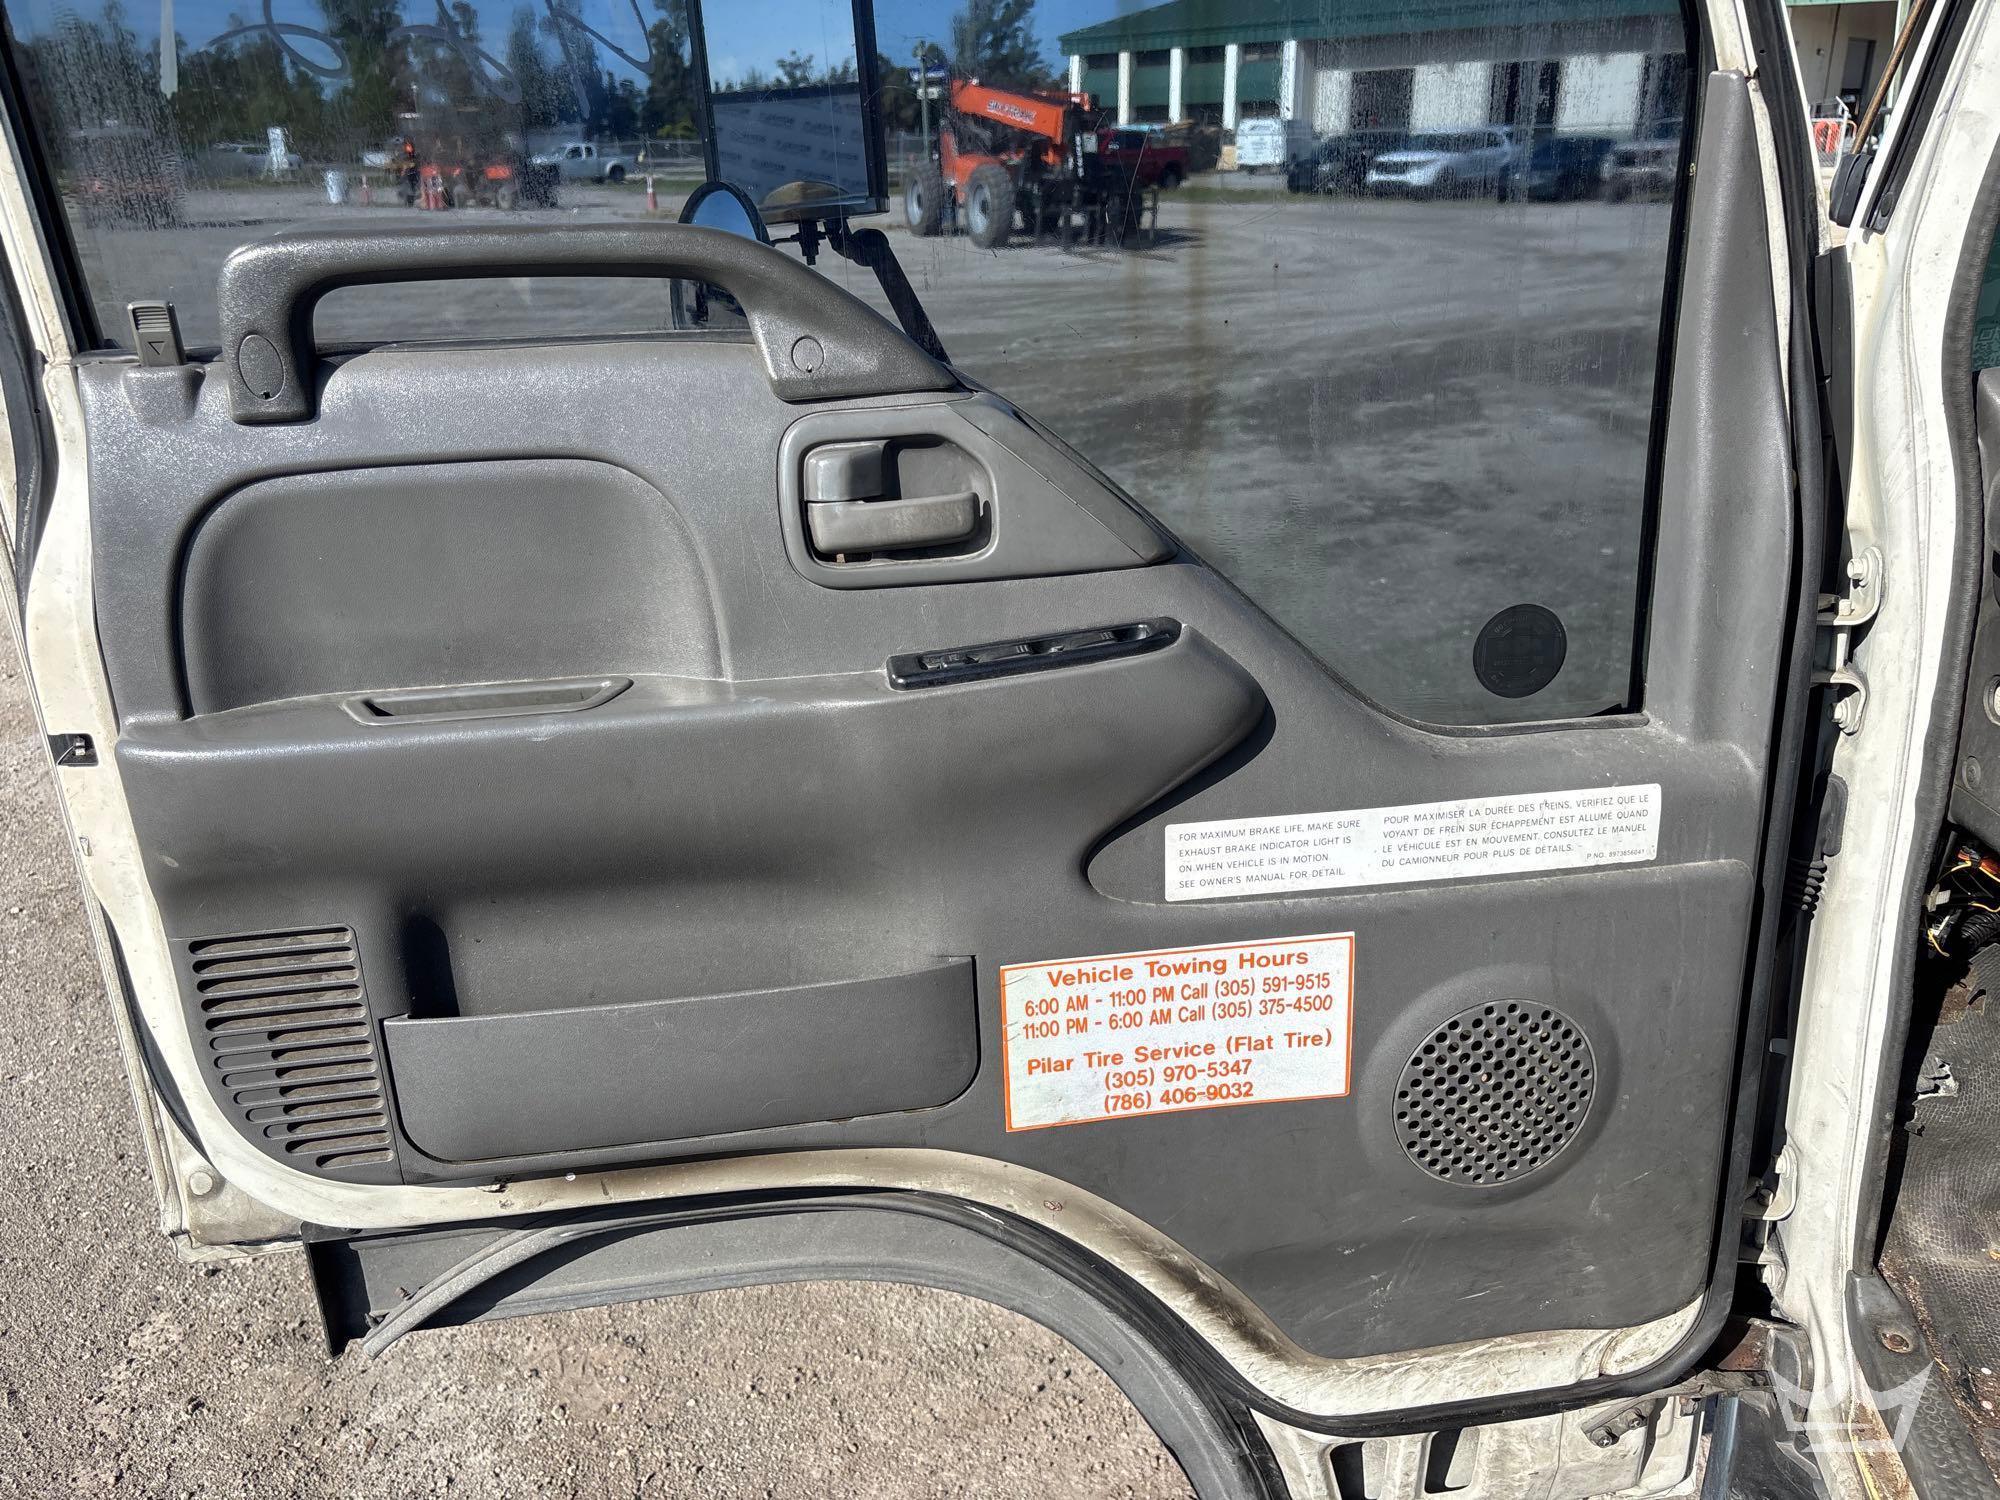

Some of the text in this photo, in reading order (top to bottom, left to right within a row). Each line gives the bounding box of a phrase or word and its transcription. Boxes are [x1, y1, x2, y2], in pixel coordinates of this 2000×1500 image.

[1383, 828, 1418, 838] VOYANT
[1424, 827, 1436, 835] DE
[1440, 824, 1464, 833] FREIN
[1469, 822, 1486, 831] SUR
[1560, 814, 1574, 824] EST
[1617, 809, 1648, 819] QUAND
[1384, 815, 1408, 824] POUR
[1414, 810, 1464, 822] MAXIMISER
[1469, 808, 1480, 816] LA
[1518, 803, 1534, 812] DES
[1617, 795, 1637, 805] QUE
[1639, 794, 1648, 802] LE
[1179, 833, 1196, 841] FOR
[1200, 829, 1246, 840] MAXIMUM
[1250, 826, 1280, 835] BRAKE
[1308, 822, 1333, 831] MAKE
[1337, 820, 1361, 828] SURE
[1383, 845, 1392, 853] LE
[1445, 838, 1460, 848] EST
[1466, 837, 1478, 846] EN
[1544, 828, 1594, 839] CONSULTEZ
[1598, 826, 1607, 834] LE
[1612, 824, 1646, 833] MANUEL
[1179, 836, 1351, 857] EXHAUST BRAKE INDICATOR LIGHT IS
[1382, 858, 1394, 867] DU
[1399, 852, 1459, 866] CAMIONNEUR
[1464, 850, 1488, 860] POUR
[1493, 848, 1515, 857] PLUS
[1520, 846, 1531, 855] DE
[1179, 865, 1191, 873] ON
[1196, 862, 1223, 871] WHEN
[1227, 858, 1264, 869] VEHICLE
[1268, 857, 1276, 865] IS
[1179, 880, 1195, 888] SEE
[1200, 875, 1241, 886] OWNER'S
[1246, 872, 1285, 882] MANUAL
[1289, 870, 1307, 879] FOR
[1048, 951, 1309, 988] Vehicle Towing Hours
[1025, 998, 1059, 1017] 6:00
[1066, 995, 1088, 1012] AM
[1110, 990, 1146, 1008] 11:00
[1153, 986, 1175, 1003] PM
[1181, 981, 1208, 1000] Call
[1214, 977, 1256, 999] (305)
[1262, 972, 1330, 992] 591-9515
[1022, 1021, 1059, 1039] 11:00
[1067, 1018, 1088, 1034] PM
[1109, 1012, 1143, 1029] 6:00
[1150, 1008, 1172, 1025] AM
[1178, 1004, 1205, 1021] Call
[1212, 1000, 1252, 1020] (305)
[1259, 995, 1333, 1016] 375-4500
[1028, 1028, 1333, 1075] Pilar Tire Service (Flat Tire)
[1105, 1059, 1252, 1091] (305) 970-5347
[1104, 1081, 1254, 1114] (786) 406-9032
